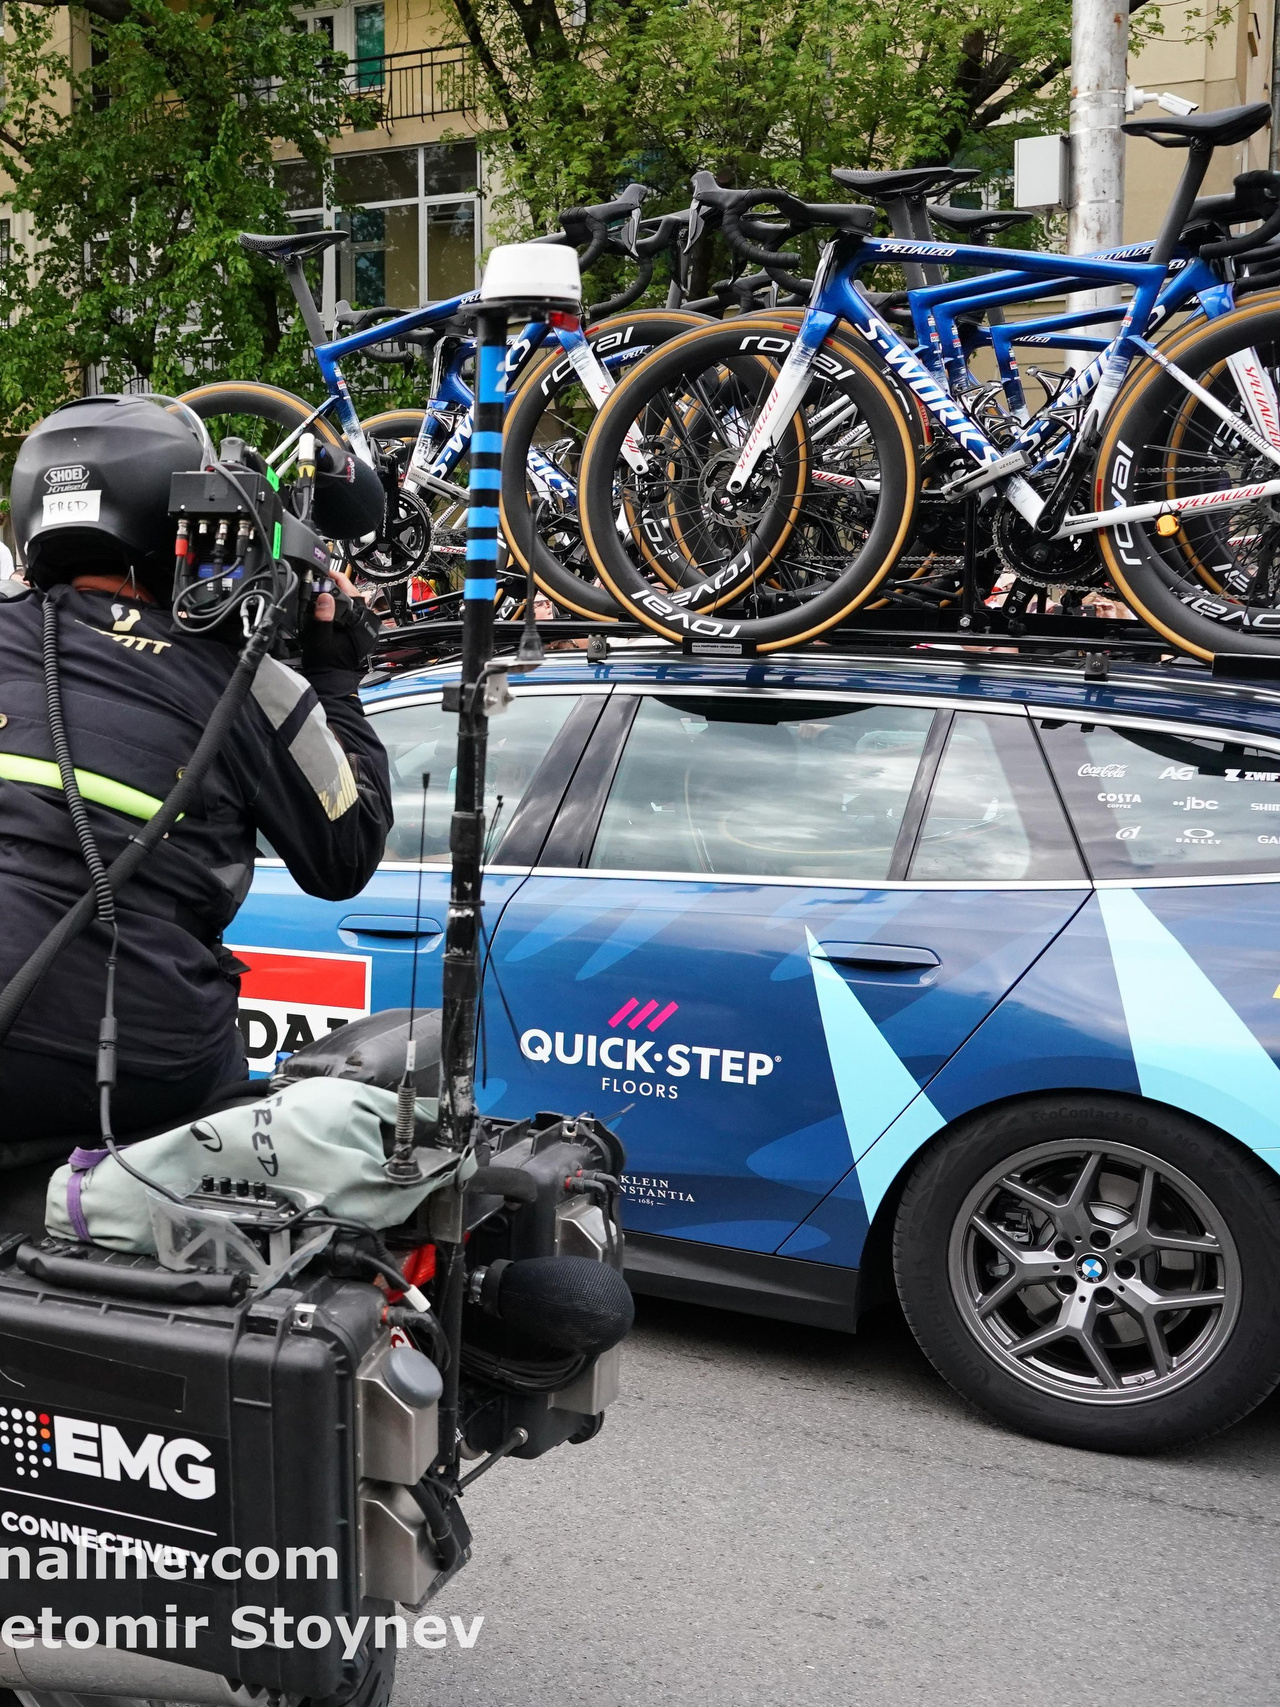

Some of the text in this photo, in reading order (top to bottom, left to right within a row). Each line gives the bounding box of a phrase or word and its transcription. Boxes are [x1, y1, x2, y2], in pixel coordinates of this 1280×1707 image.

[875, 243, 957, 257] SPECIALIZED
[541, 326, 634, 396] roal
[739, 336, 856, 380] roal
[855, 318, 1002, 467] S-WORKS
[736, 388, 779, 472] SPECIALIZED
[1227, 414, 1270, 450] SHIMANO
[50, 468, 83, 483] SHOEI
[48, 500, 89, 514] FRED
[1177, 486, 1266, 510] SPECIALIZED
[668, 550, 752, 606] rova
[630, 590, 742, 638] roval
[1077, 763, 1129, 778] Coca-Cola
[1244, 772, 1280, 782] ZWIF
[1097, 792, 1142, 803] COSTA
[1251, 803, 1280, 811] SHIM
[1175, 837, 1222, 845] OAKLEY
[602, 1078, 679, 1099] FLOORS
[621, 1175, 669, 1189] KLEIN
[620, 1186, 695, 1202] NSTANTIA
[638, 1198, 654, 1206] 1685
[53, 1415, 217, 1500] EMG
[1, 1511, 210, 1574] CONNECTIVITY
